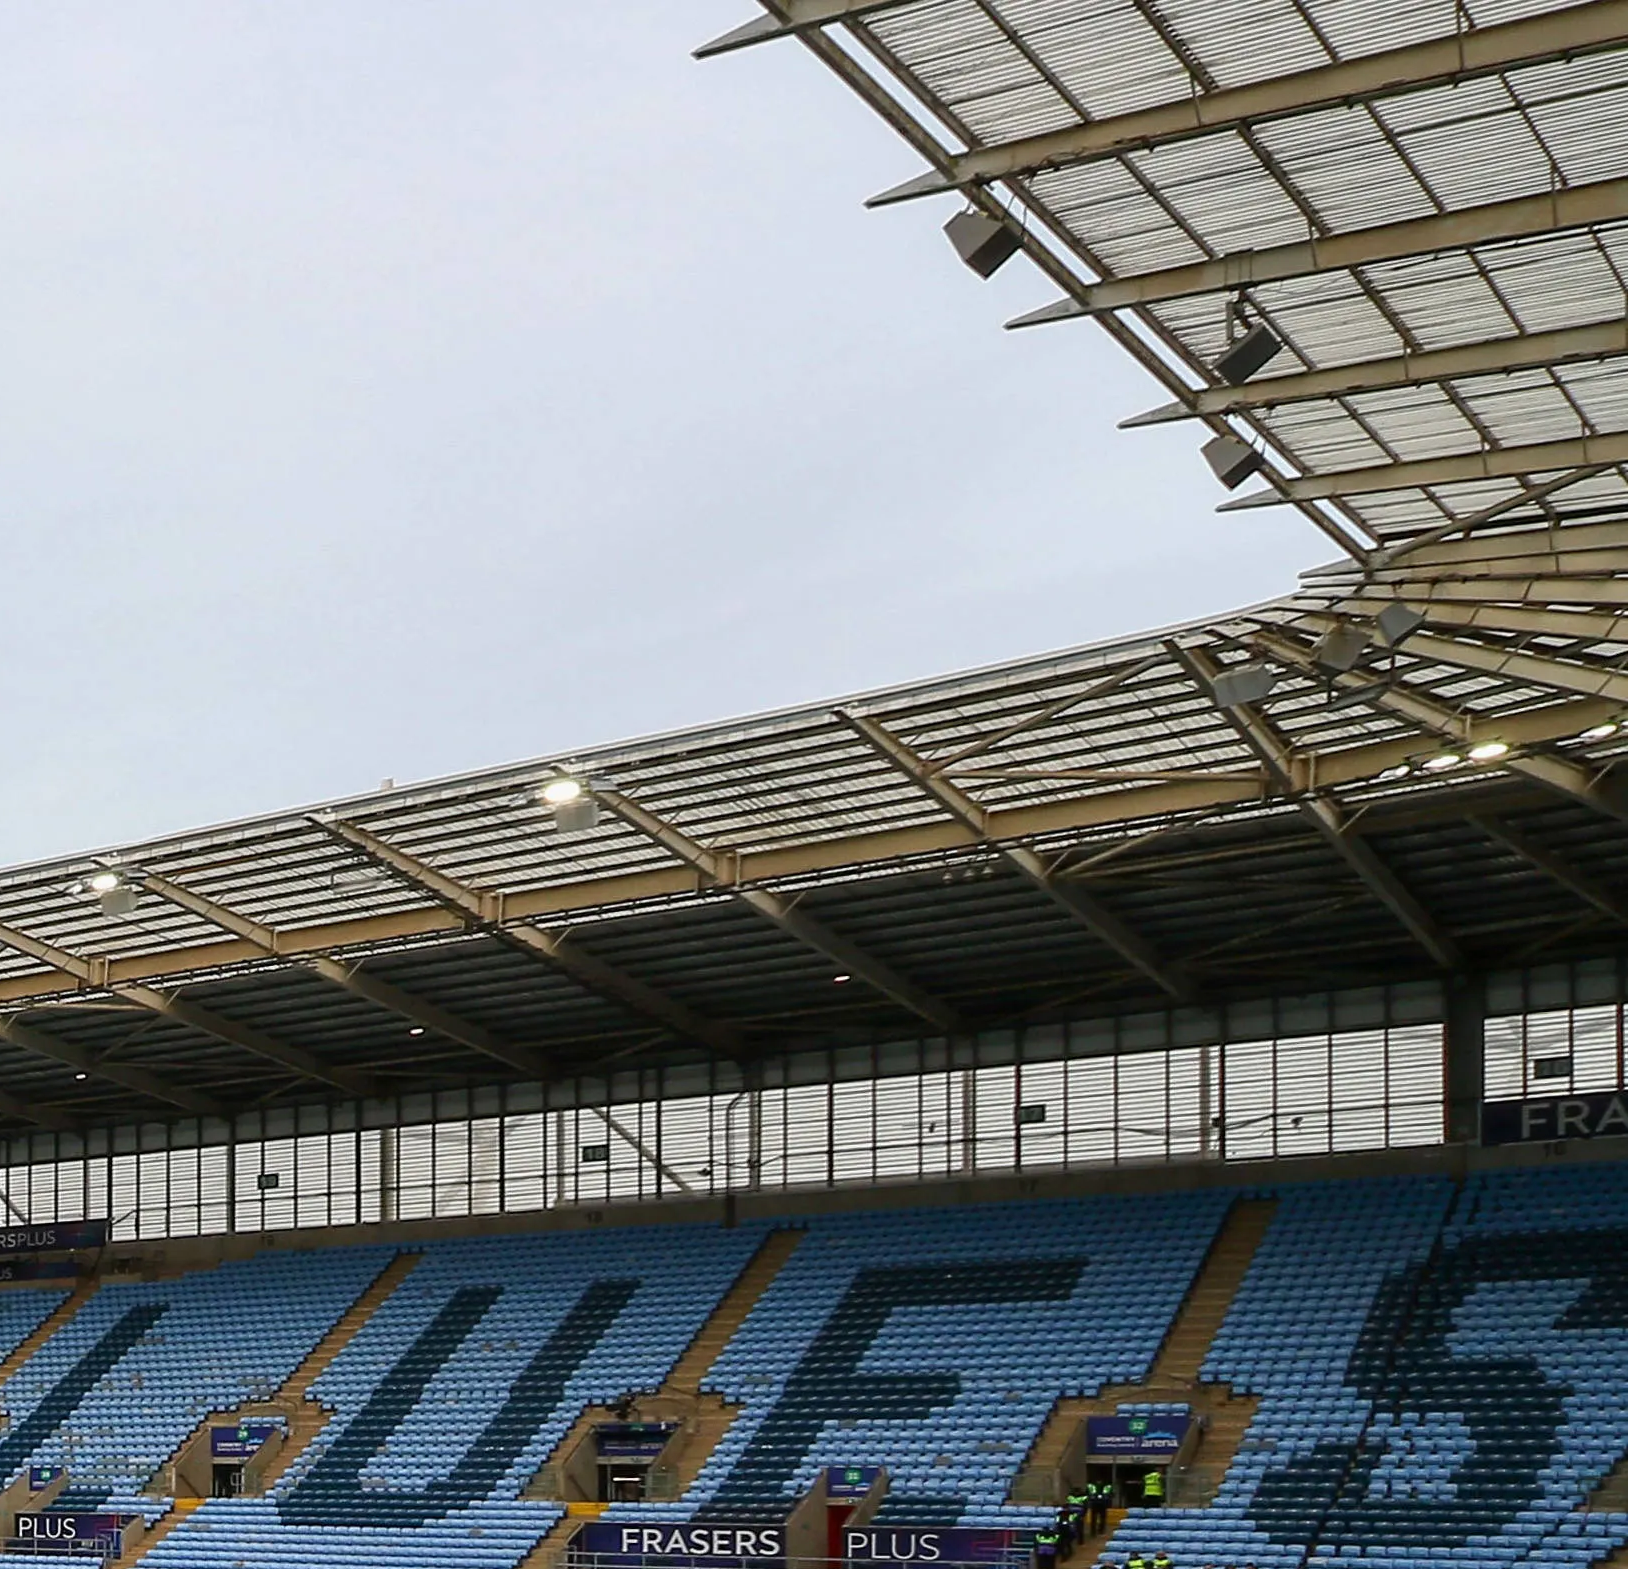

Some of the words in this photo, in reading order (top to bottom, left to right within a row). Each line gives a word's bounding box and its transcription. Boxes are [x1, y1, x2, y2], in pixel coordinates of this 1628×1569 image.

[1521, 1096, 1628, 1139] FRA
[18, 1517, 76, 1539] PLUS
[621, 1528, 780, 1556] FRASERS
[848, 1532, 940, 1560] PLUS
